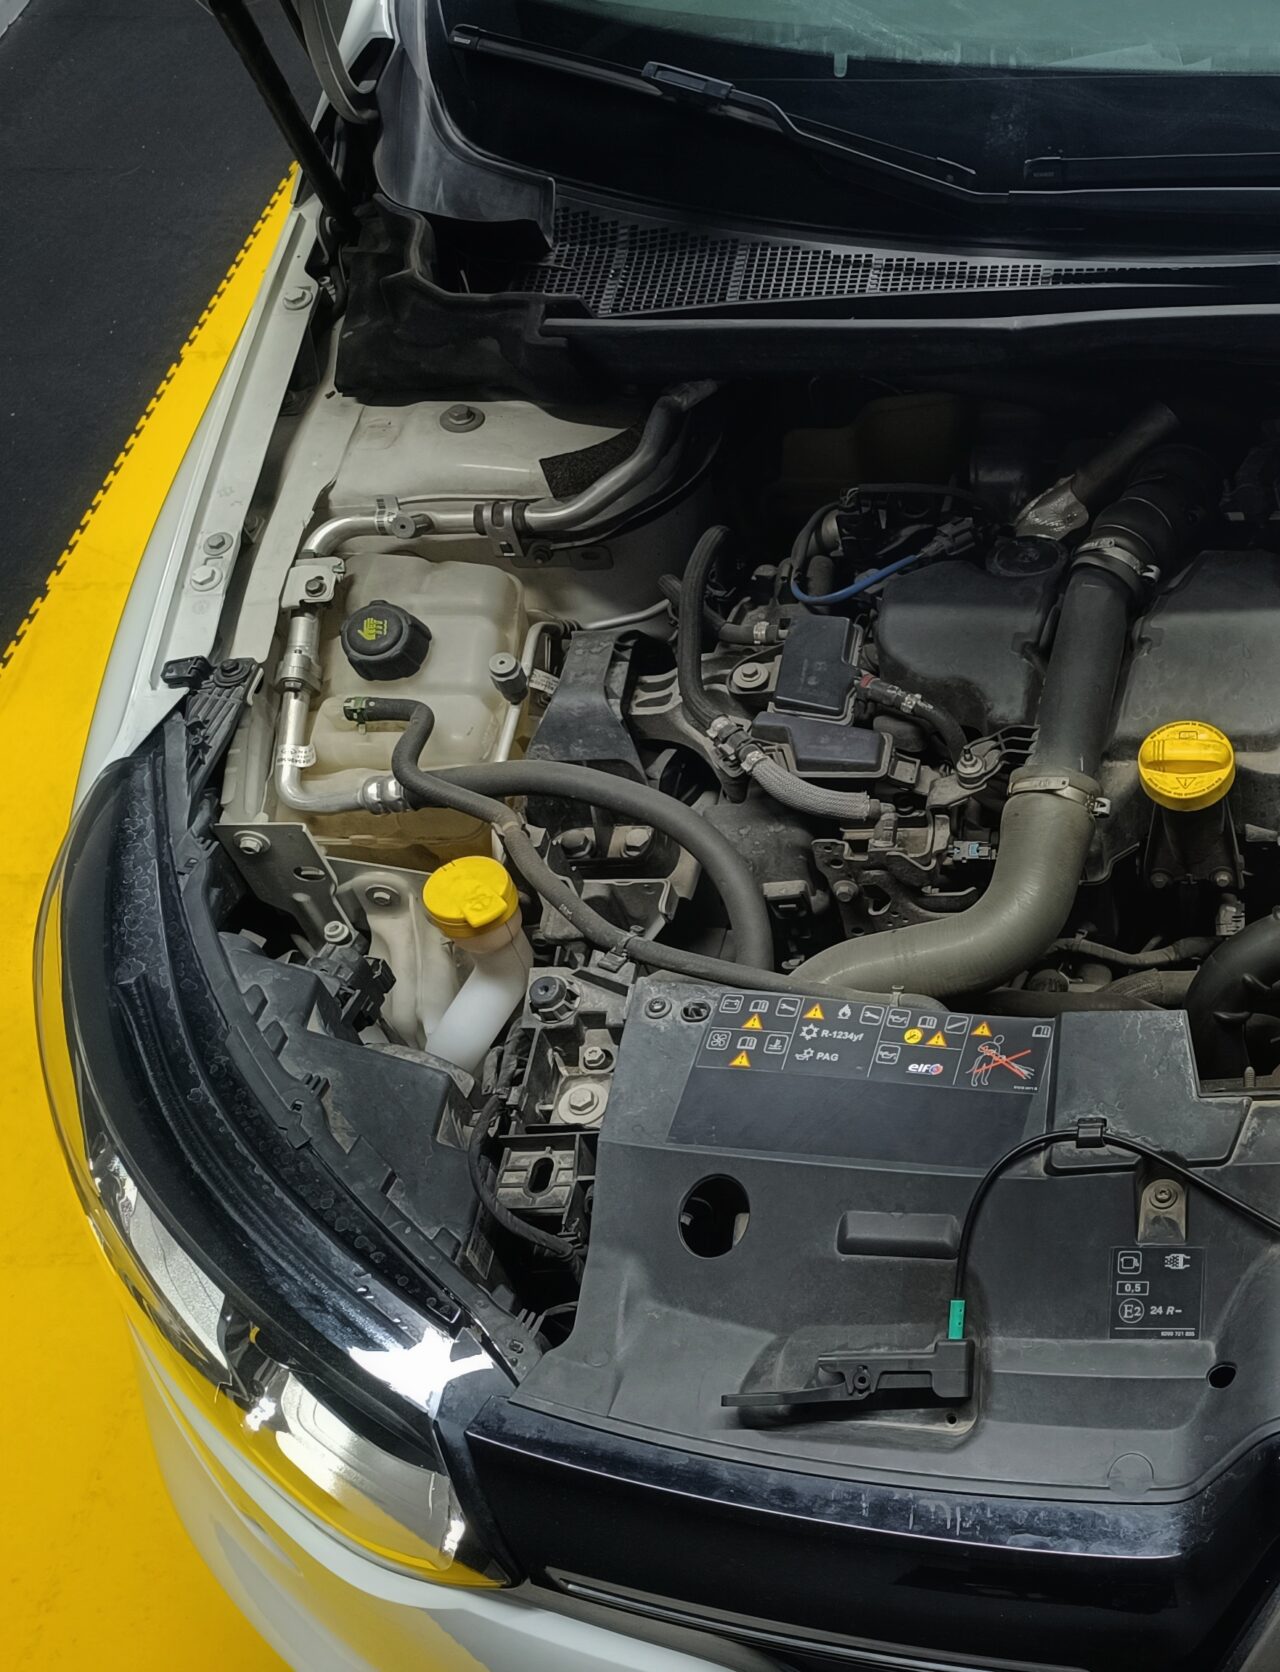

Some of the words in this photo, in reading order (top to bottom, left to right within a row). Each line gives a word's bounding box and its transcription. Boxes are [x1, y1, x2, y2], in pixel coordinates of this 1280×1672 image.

[820, 1029, 864, 1042] R-1234yf
[816, 1052, 839, 1061] PAG
[908, 1063, 930, 1073] elf
[1124, 1283, 1141, 1293] 0,5
[1123, 1304, 1142, 1319] E2
[1150, 1306, 1163, 1315] 24
